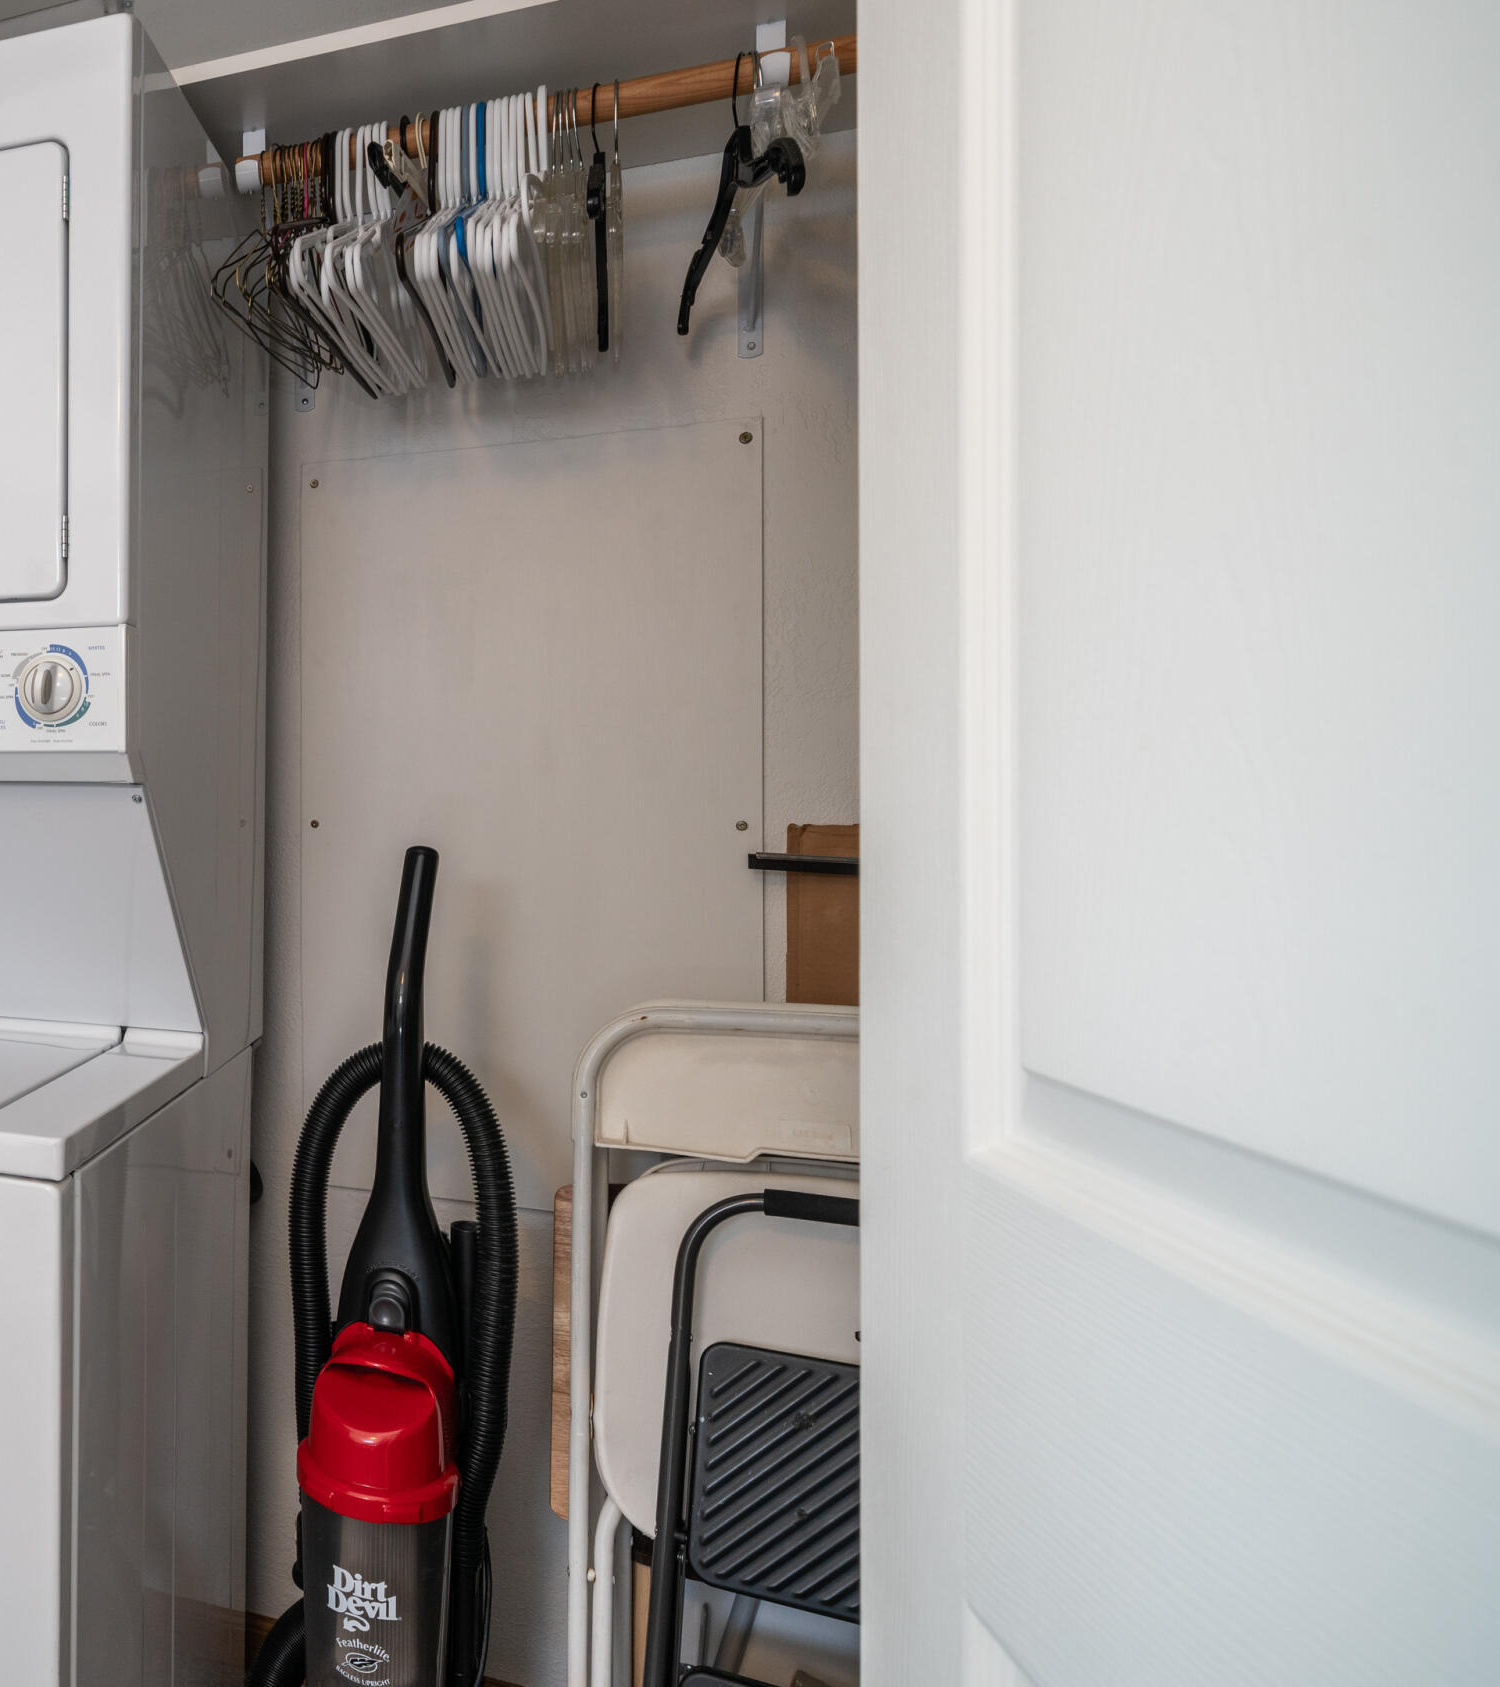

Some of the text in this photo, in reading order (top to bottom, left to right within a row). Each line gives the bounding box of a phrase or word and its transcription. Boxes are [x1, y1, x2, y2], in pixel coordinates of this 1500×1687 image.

[327, 1583, 399, 1621] Devil
[332, 1564, 388, 1602] Dirt
[335, 1637, 391, 1662] Featherlite
